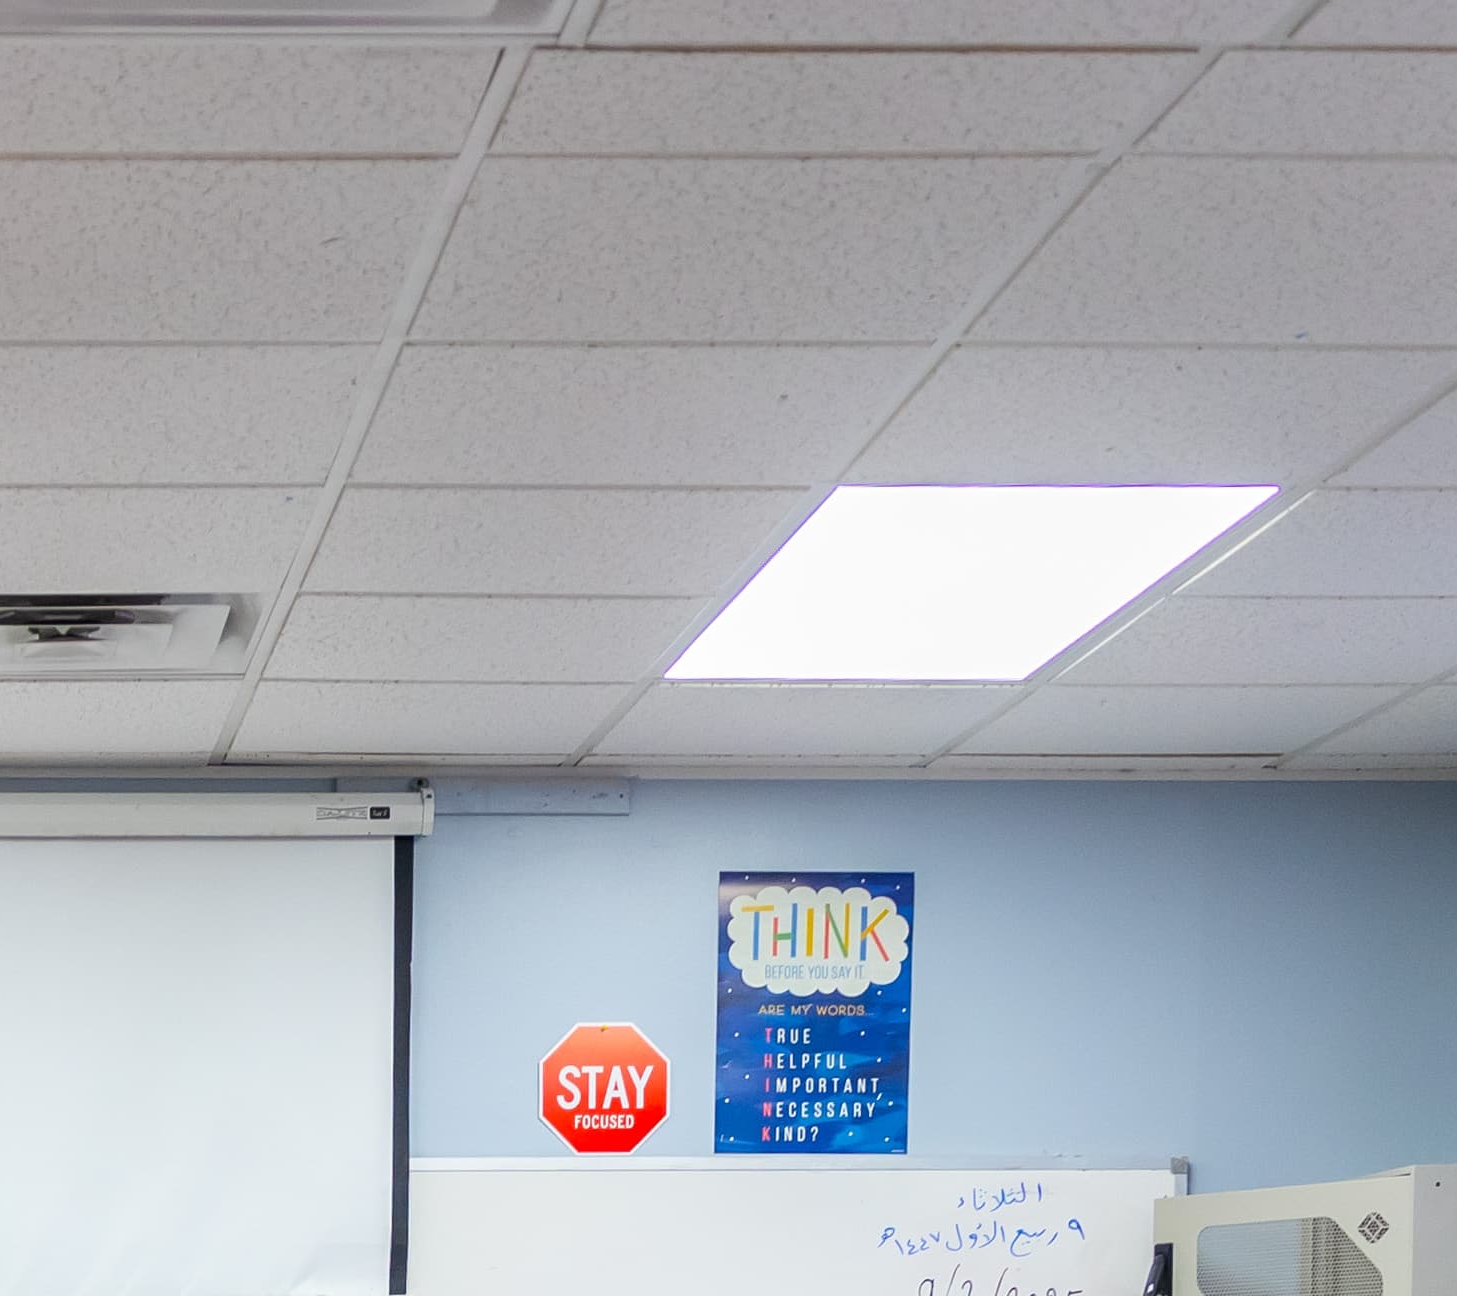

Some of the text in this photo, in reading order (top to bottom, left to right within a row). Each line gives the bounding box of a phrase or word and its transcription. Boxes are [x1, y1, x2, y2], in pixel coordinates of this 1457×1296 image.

[741, 902, 890, 962] THINK
[764, 964, 804, 980] BEFORE
[808, 964, 829, 980] YOU
[831, 964, 852, 979] SAY
[757, 1004, 784, 1016] ARE
[791, 1003, 813, 1016] MY
[764, 1027, 812, 1044] TRUE
[763, 1053, 847, 1070] HELPFUL
[556, 1064, 654, 1111] STAY
[762, 1101, 876, 1119] NECESSARY
[574, 1114, 635, 1130] FOCUSED
[761, 1126, 819, 1143] KIND?
